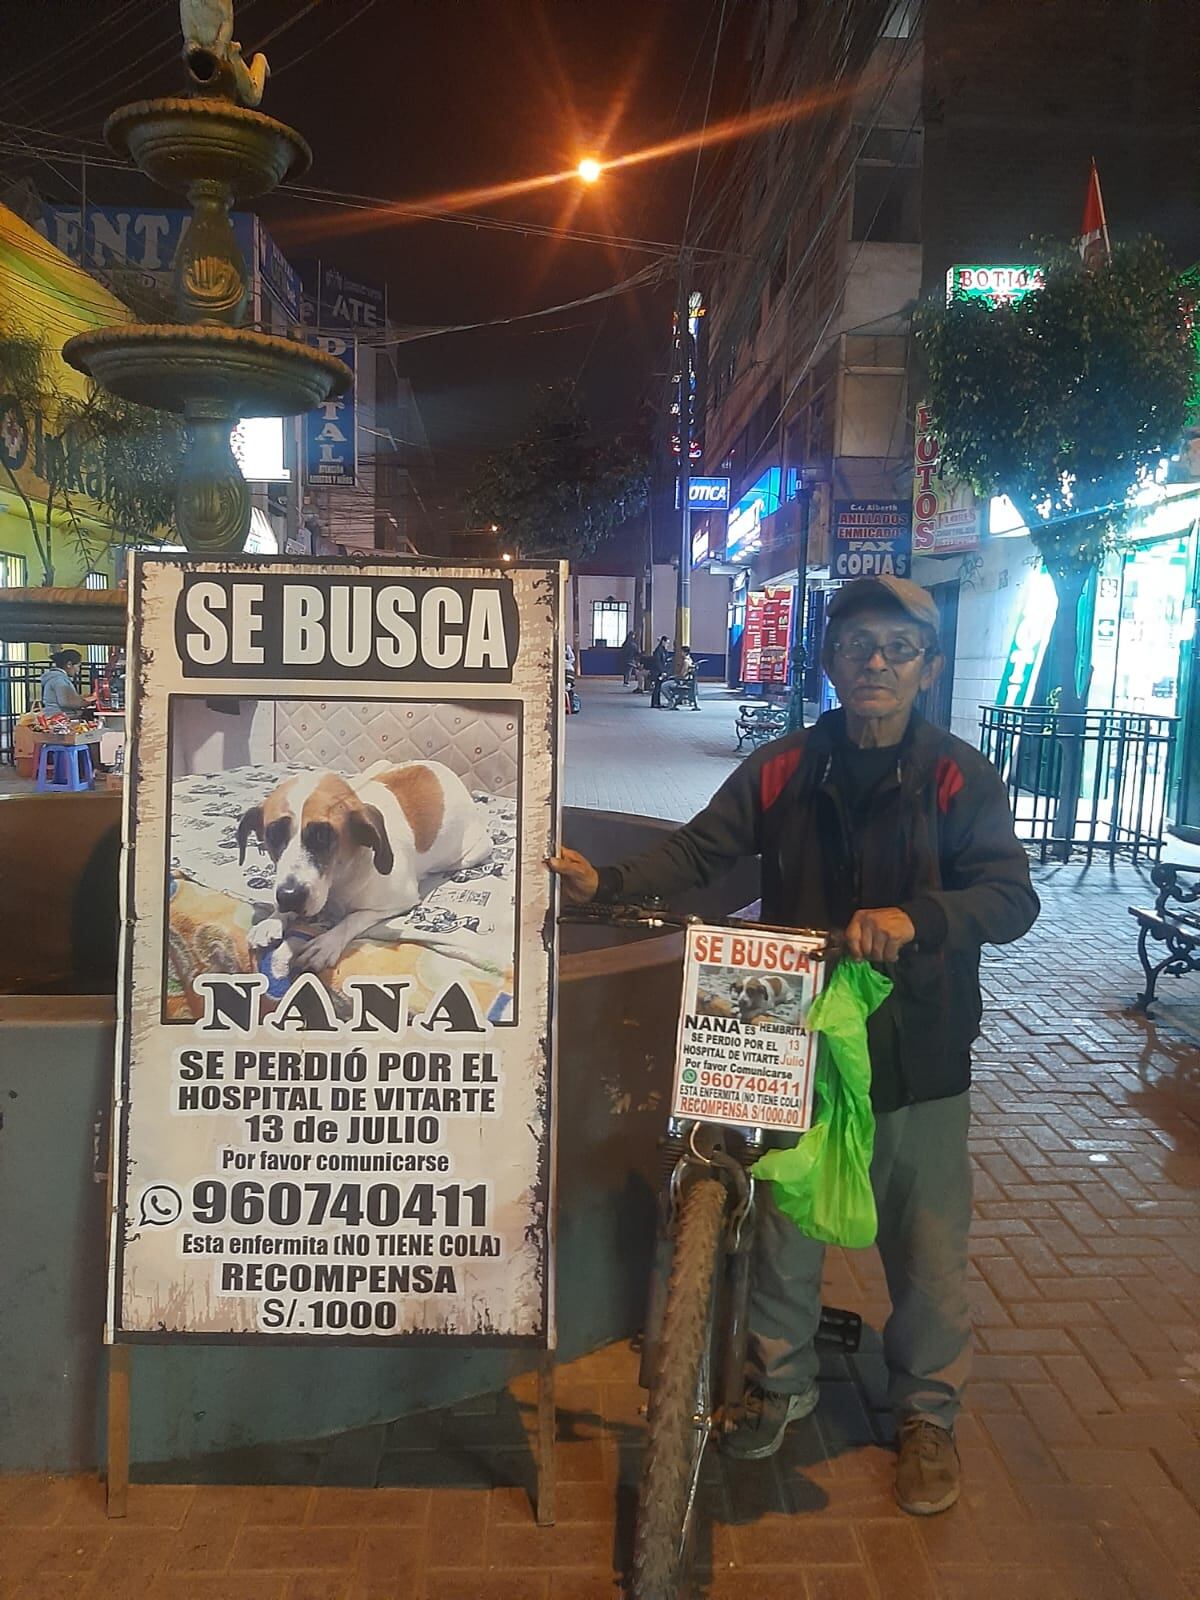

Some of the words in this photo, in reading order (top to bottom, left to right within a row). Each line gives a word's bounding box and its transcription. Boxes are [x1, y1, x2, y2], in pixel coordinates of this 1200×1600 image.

[332, 294, 377, 327] ATE
[315, 336, 347, 462] DTAL
[914, 406, 939, 550] FOTOS
[688, 484, 727, 501] OTICA
[839, 513, 907, 525] ANILLADOS
[838, 527, 907, 539] ENMICADOS
[848, 541, 895, 552] FAX
[836, 552, 906, 575] COPIAS
[185, 580, 266, 666] SE
[281, 583, 510, 669] BUSCA
[693, 934, 724, 963] SE
[730, 938, 811, 974] BUSCA
[200, 980, 487, 1034] NANA
[684, 1014, 741, 1035] NANA
[744, 1025, 756, 1036] ES
[759, 1022, 807, 1037] HEMBRITA
[690, 1032, 704, 1043] SE
[705, 1034, 742, 1048] PERDIO
[743, 1038, 764, 1050] POR
[766, 1041, 778, 1051] EL
[789, 1039, 800, 1051] 13
[178, 1049, 226, 1081] SE
[233, 1046, 369, 1083] PERDIÓ
[377, 1051, 452, 1082] POR
[461, 1052, 499, 1083] EL
[683, 1044, 726, 1059] HOSPITAL
[728, 1050, 740, 1060] DE
[742, 1051, 780, 1065] VITARTE
[780, 1053, 805, 1067] Julio
[684, 1057, 701, 1069] Por
[703, 1059, 728, 1073] favor
[729, 1063, 793, 1080] Comunicarse
[679, 1084, 698, 1097] ESTA
[699, 1086, 740, 1101] ENFERMITA
[756, 1093, 778, 1106] TIENE
[699, 1071, 801, 1097] 960740411
[177, 1085, 323, 1112] HOSPITAL
[329, 1086, 368, 1112] DE
[374, 1087, 496, 1113] VITARTE
[680, 1096, 749, 1119] RECOMPENSA
[244, 1114, 284, 1143] 13
[293, 1115, 339, 1144] de
[346, 1116, 440, 1145] JULIO
[222, 1149, 257, 1171] Por
[259, 1149, 313, 1172] favor
[315, 1150, 450, 1173] comunicarse
[191, 1180, 487, 1228] 960740411
[181, 1233, 225, 1255] Esta
[228, 1233, 329, 1256] enfermita
[333, 1234, 370, 1257] (NO
[375, 1234, 434, 1257] TIENE
[439, 1235, 501, 1258] COLA)
[220, 1262, 457, 1294] RECOMPENSA
[261, 1298, 397, 1330] S/.1000
